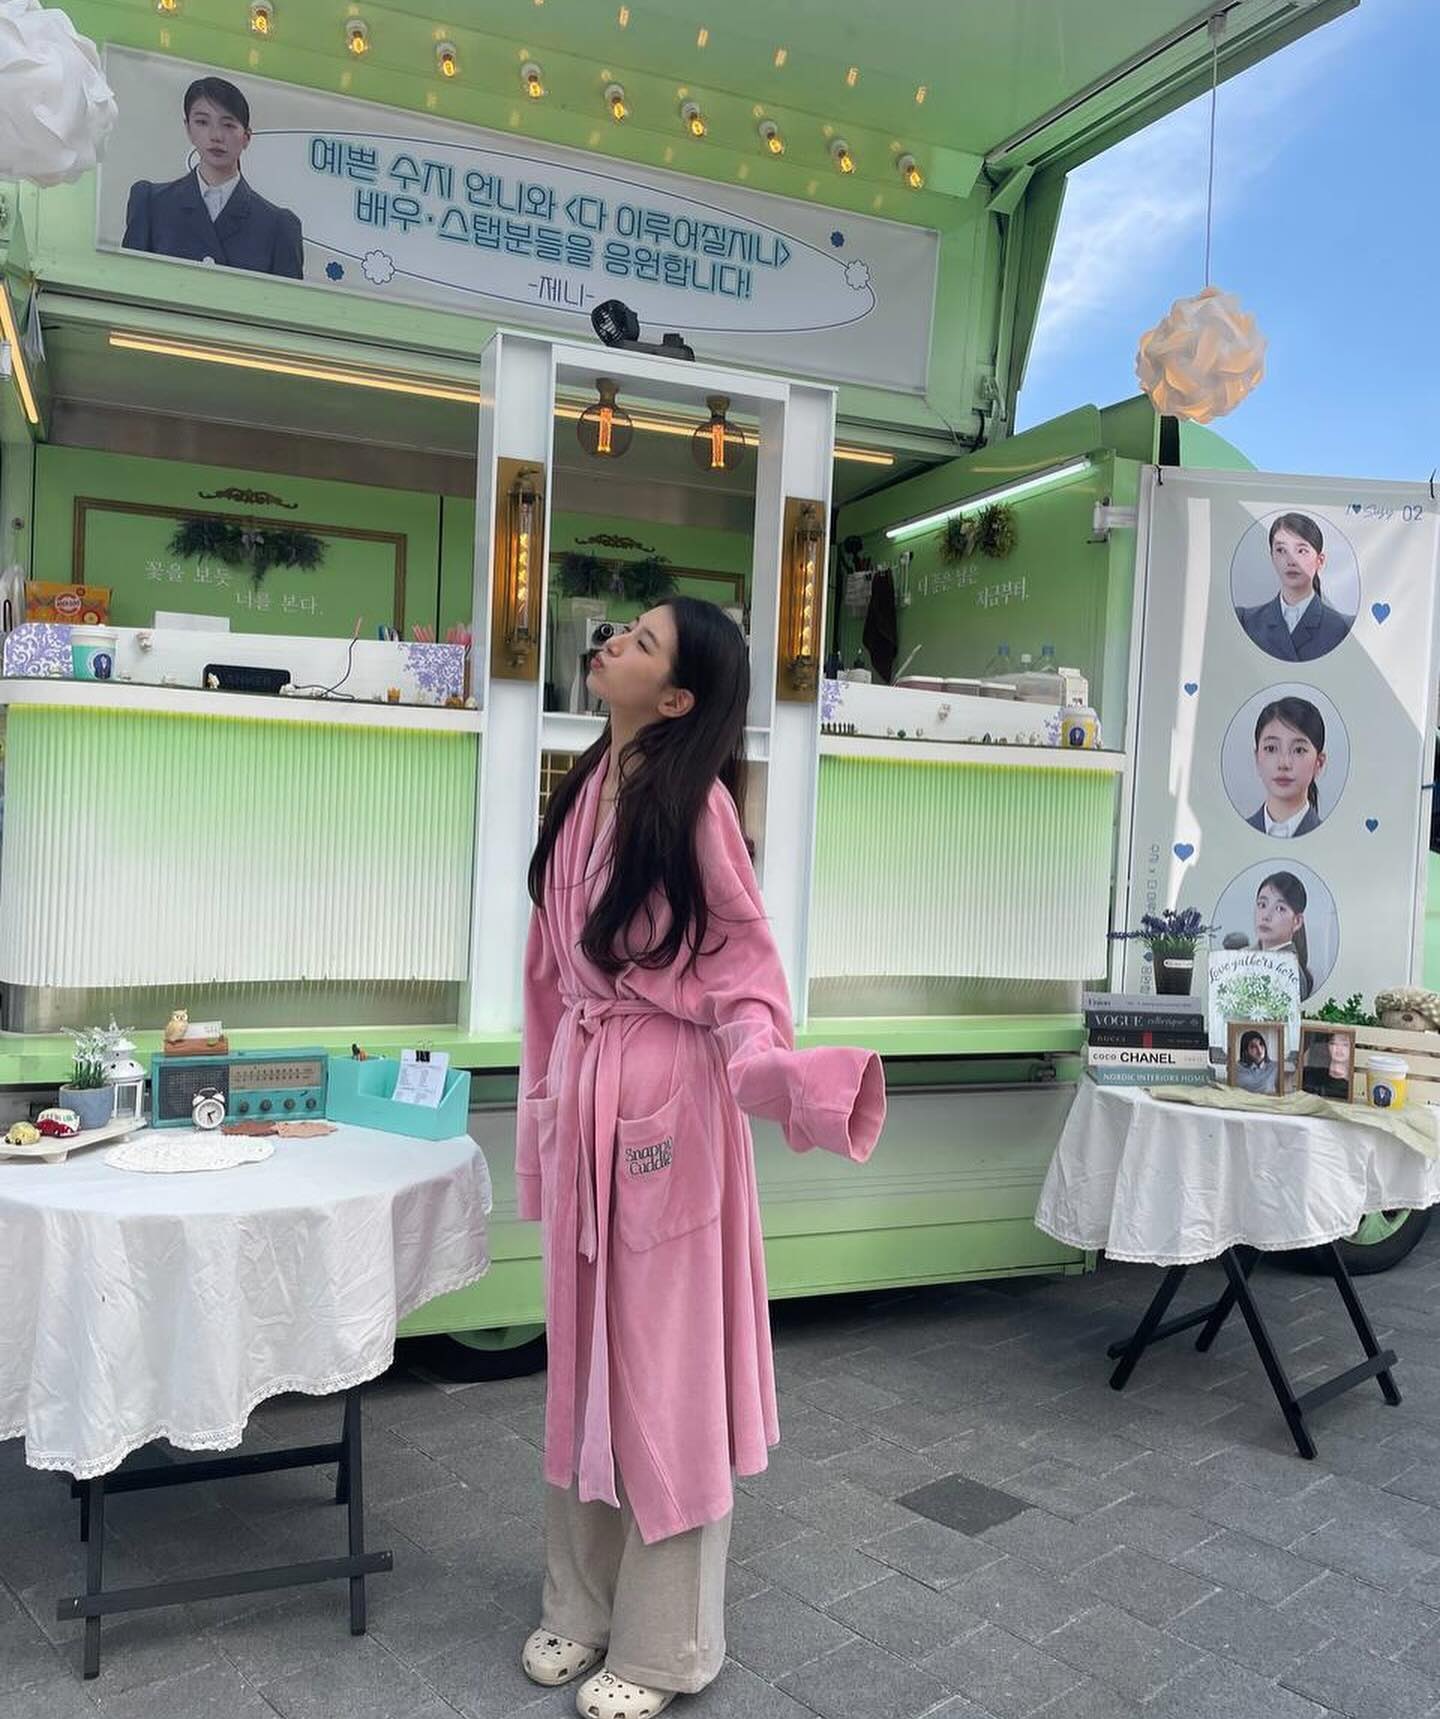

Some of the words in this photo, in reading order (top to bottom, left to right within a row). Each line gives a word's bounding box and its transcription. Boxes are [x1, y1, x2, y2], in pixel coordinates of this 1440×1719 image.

[311, 137, 378, 183] 예쁜
[389, 155, 453, 200] 수지
[465, 171, 556, 220] 언니와
[564, 196, 608, 231] <다
[616, 205, 792, 268] 이루어질지니>
[603, 241, 751, 299] 응원합니다!
[1402, 504, 1423, 521] 02
[145, 560, 185, 583] 꽃을
[193, 561, 231, 592] 보듯
[236, 589, 270, 611] 너를
[1209, 962, 1231, 984] Love
[1231, 953, 1273, 972] gathers
[1275, 961, 1298, 983] here
[1094, 1013, 1144, 1027] VOGUE
[1120, 1051, 1176, 1064] CHANEL
